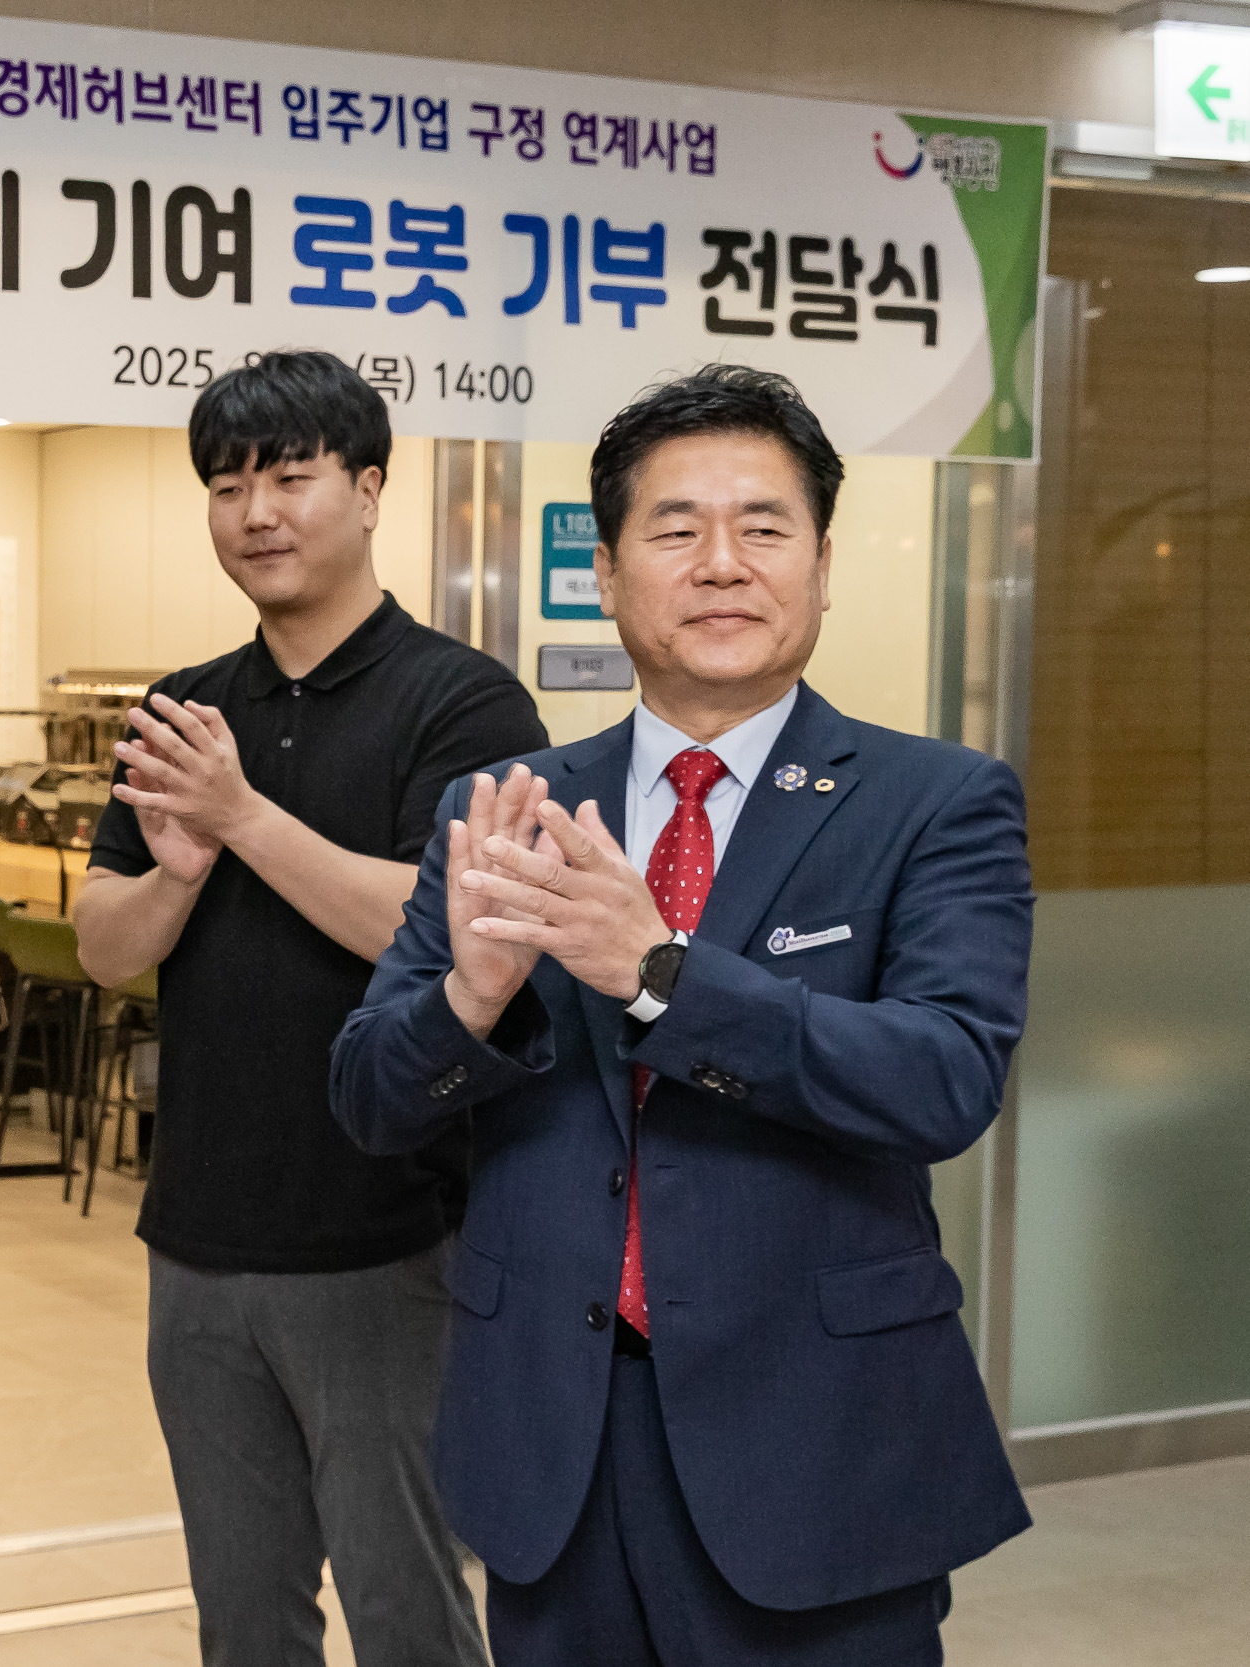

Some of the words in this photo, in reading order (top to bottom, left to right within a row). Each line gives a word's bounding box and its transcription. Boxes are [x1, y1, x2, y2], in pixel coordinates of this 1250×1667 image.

[281, 84, 449, 152] 입주기업
[467, 102, 544, 162] 구정
[563, 111, 717, 176] 연계사업
[61, 179, 252, 303] 기여
[291, 196, 468, 317] 로봇
[503, 213, 666, 328] 기부
[700, 227, 939, 347] 전달식
[434, 361, 534, 403] 14:00
